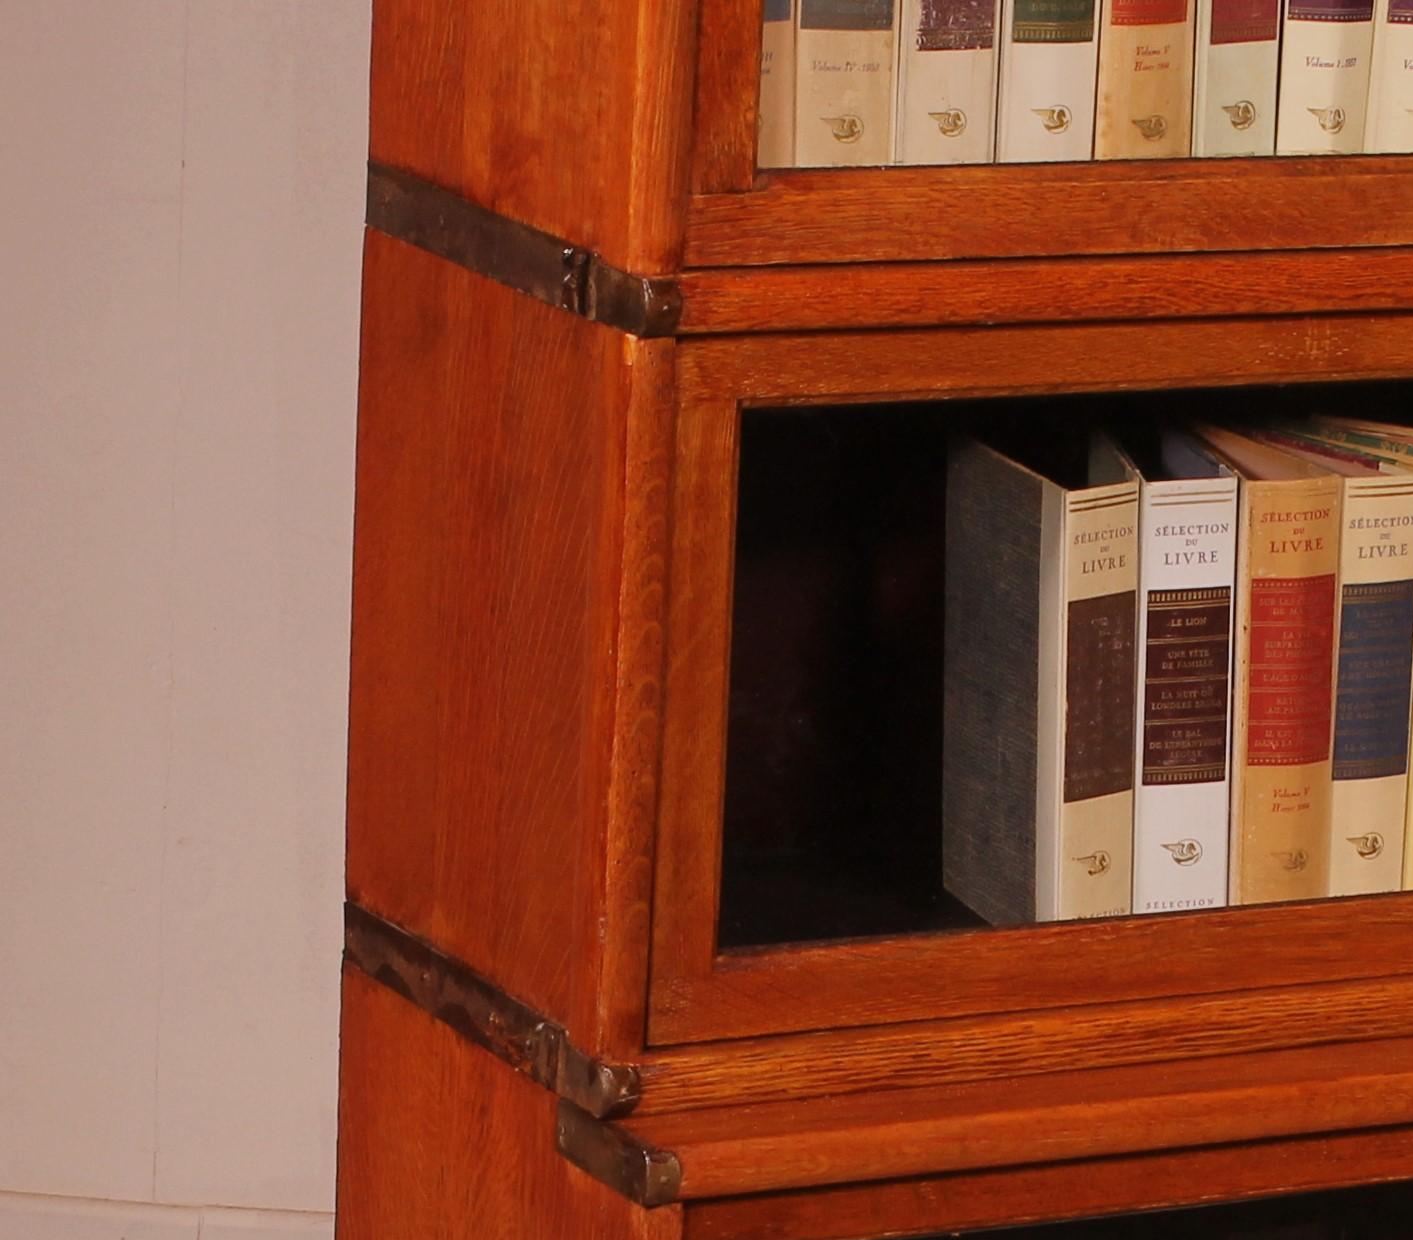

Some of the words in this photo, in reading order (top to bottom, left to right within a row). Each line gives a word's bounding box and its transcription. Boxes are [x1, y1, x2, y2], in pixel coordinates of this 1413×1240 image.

[1306, 56, 1336, 68] Volume
[1260, 508, 1330, 523] SÉLECTION
[1155, 523, 1230, 537] SÉLECTION
[1185, 539, 1198, 547] DU
[1269, 538, 1324, 553] LIVRE
[1358, 543, 1408, 559] LIVRE
[1082, 555, 1126, 574] LIVRE
[1164, 551, 1218, 566] LIVRE
[1171, 619, 1182, 628] LE
[1185, 617, 1207, 627] LION
[1273, 789, 1301, 799] Volume
